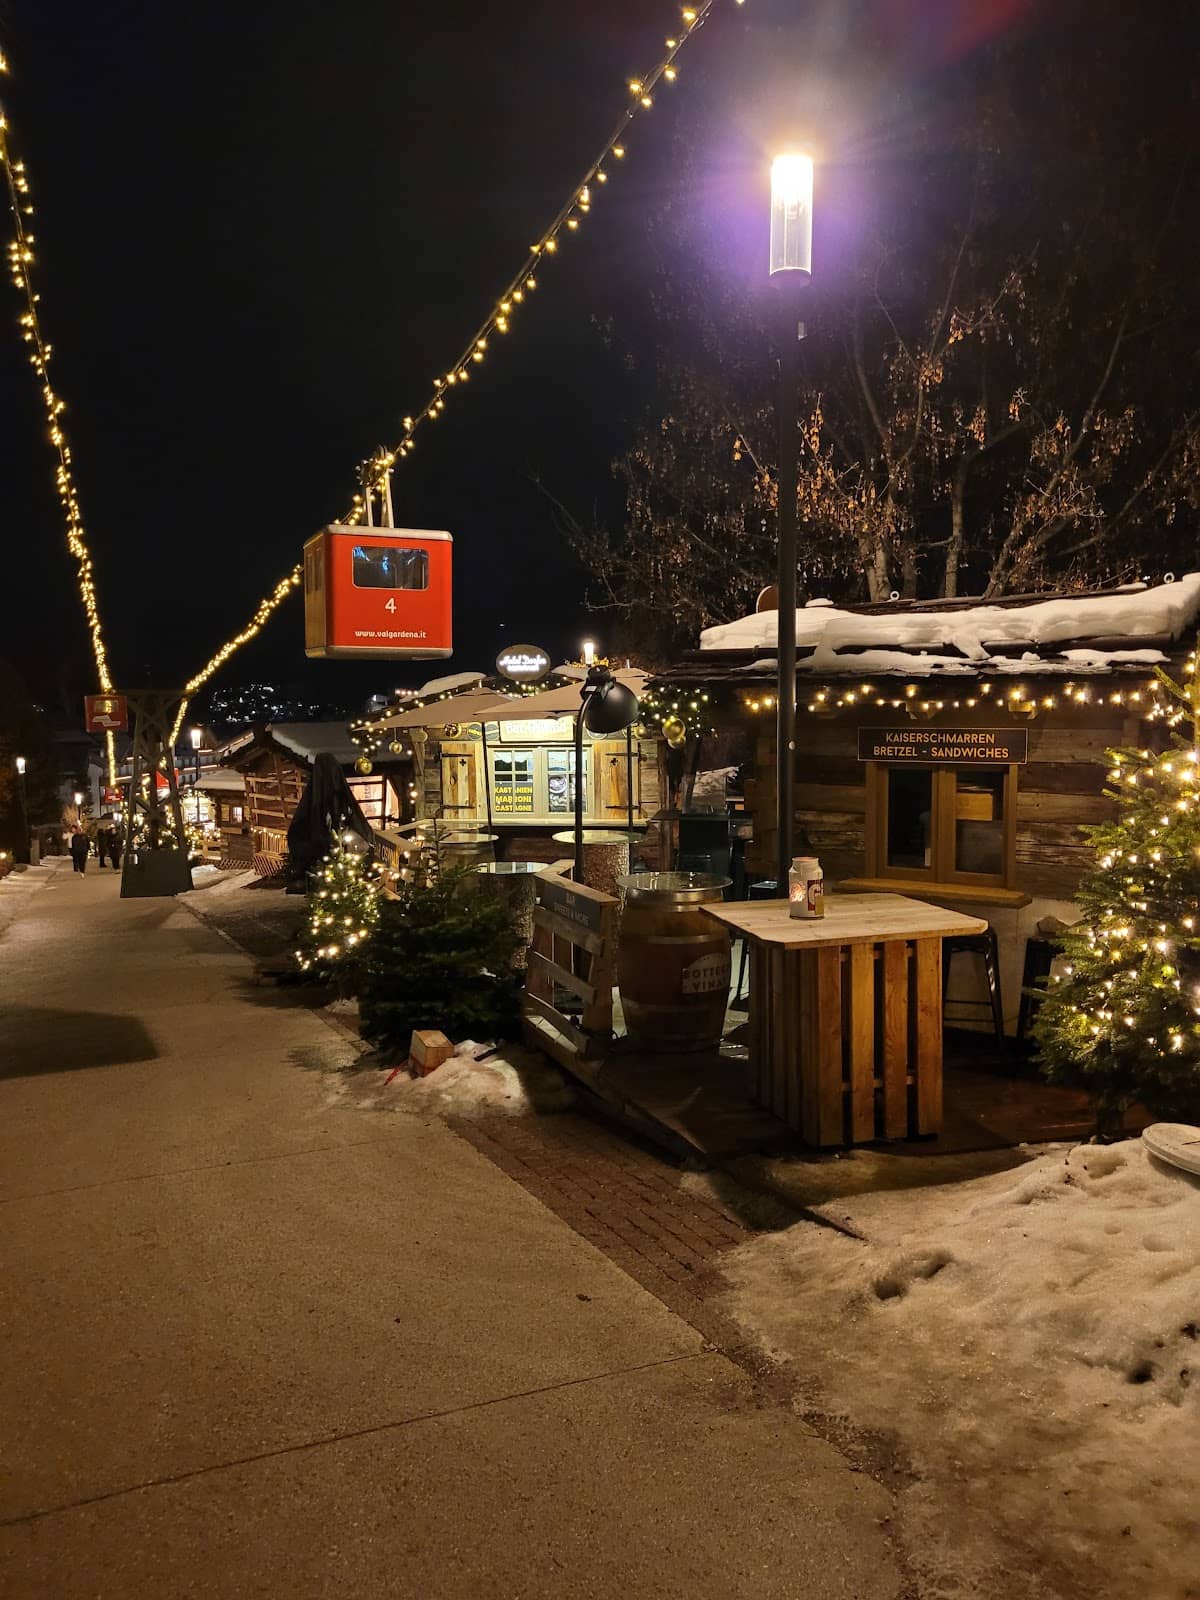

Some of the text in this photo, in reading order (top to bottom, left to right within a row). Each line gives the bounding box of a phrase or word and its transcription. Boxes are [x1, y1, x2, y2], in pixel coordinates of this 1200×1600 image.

[385, 597, 397, 614] 4
[354, 630, 427, 639] www.valgardena.it
[886, 732, 995, 744] KAISERSCHMARREN
[873, 745, 918, 757] BRETZEL
[931, 747, 1009, 759] SANDWICHES
